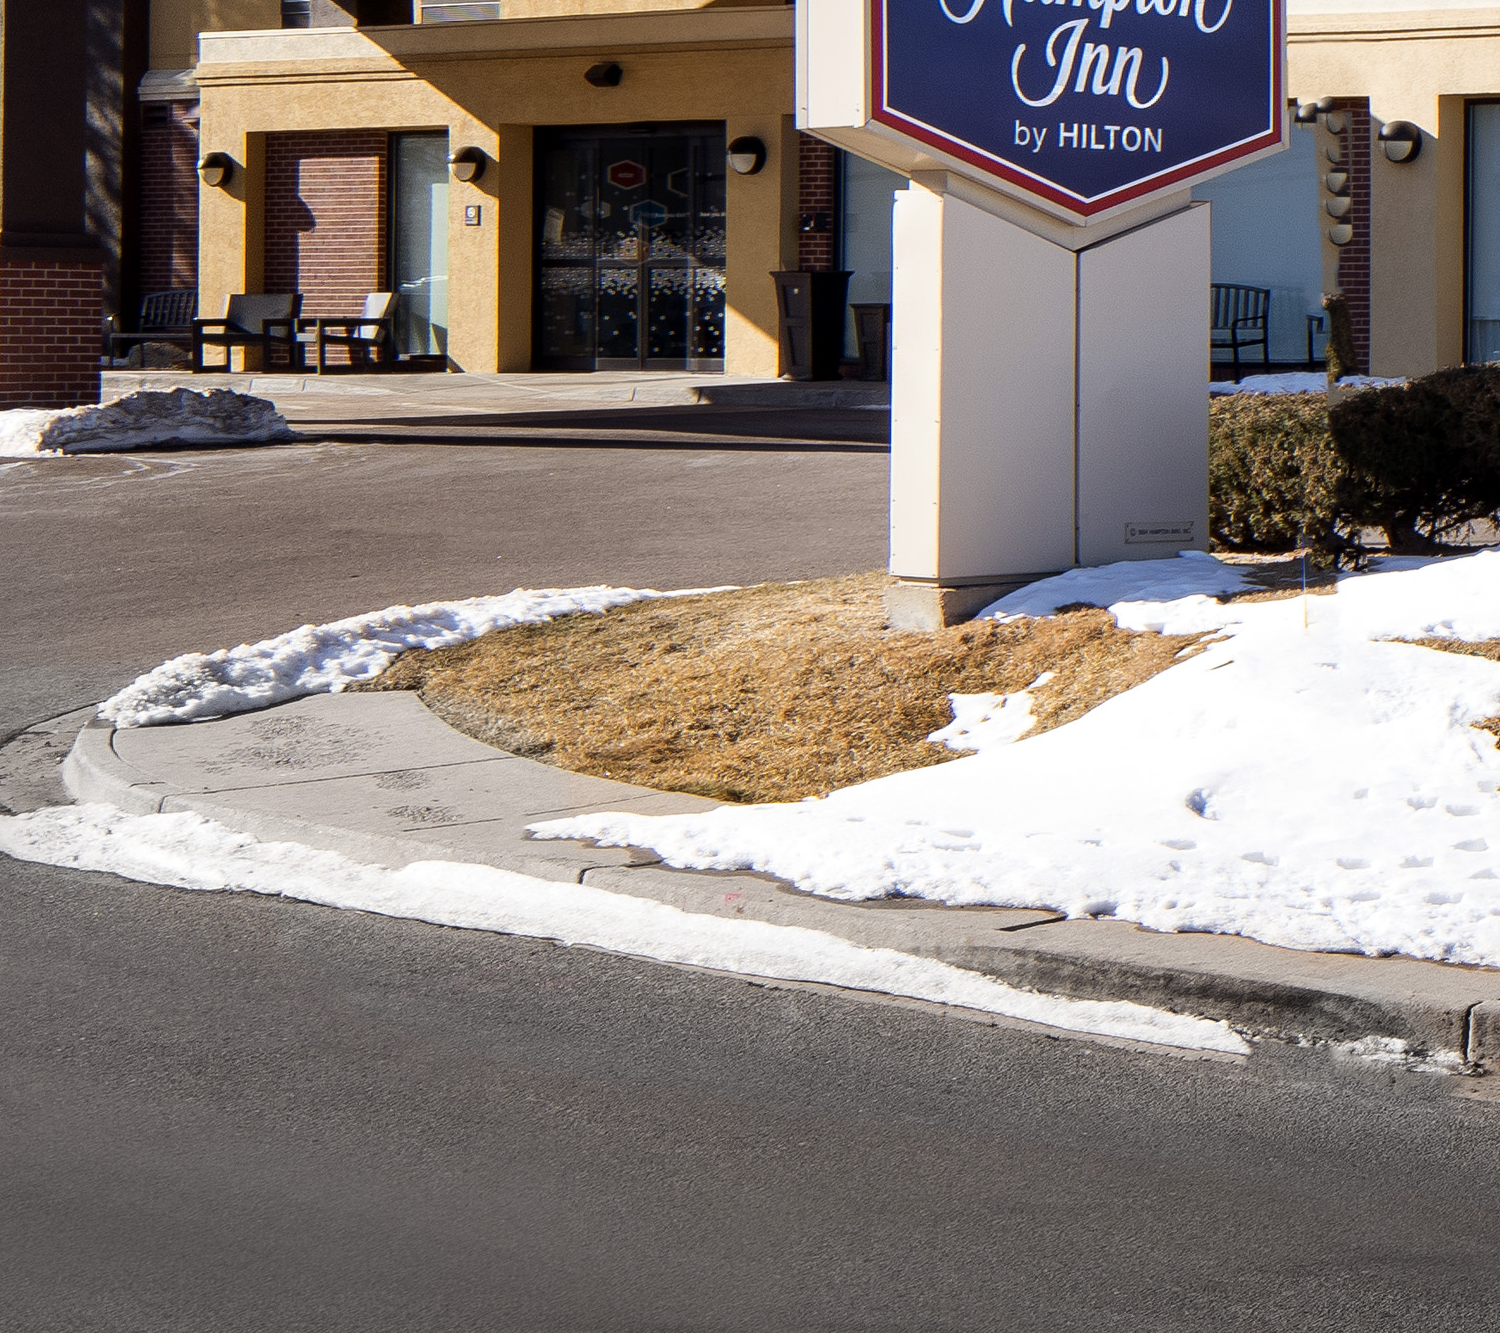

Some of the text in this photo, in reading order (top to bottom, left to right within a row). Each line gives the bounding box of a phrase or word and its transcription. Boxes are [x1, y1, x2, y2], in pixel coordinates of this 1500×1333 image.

[1011, 18, 1169, 109] Inn
[1014, 119, 1164, 154] by HILTON
